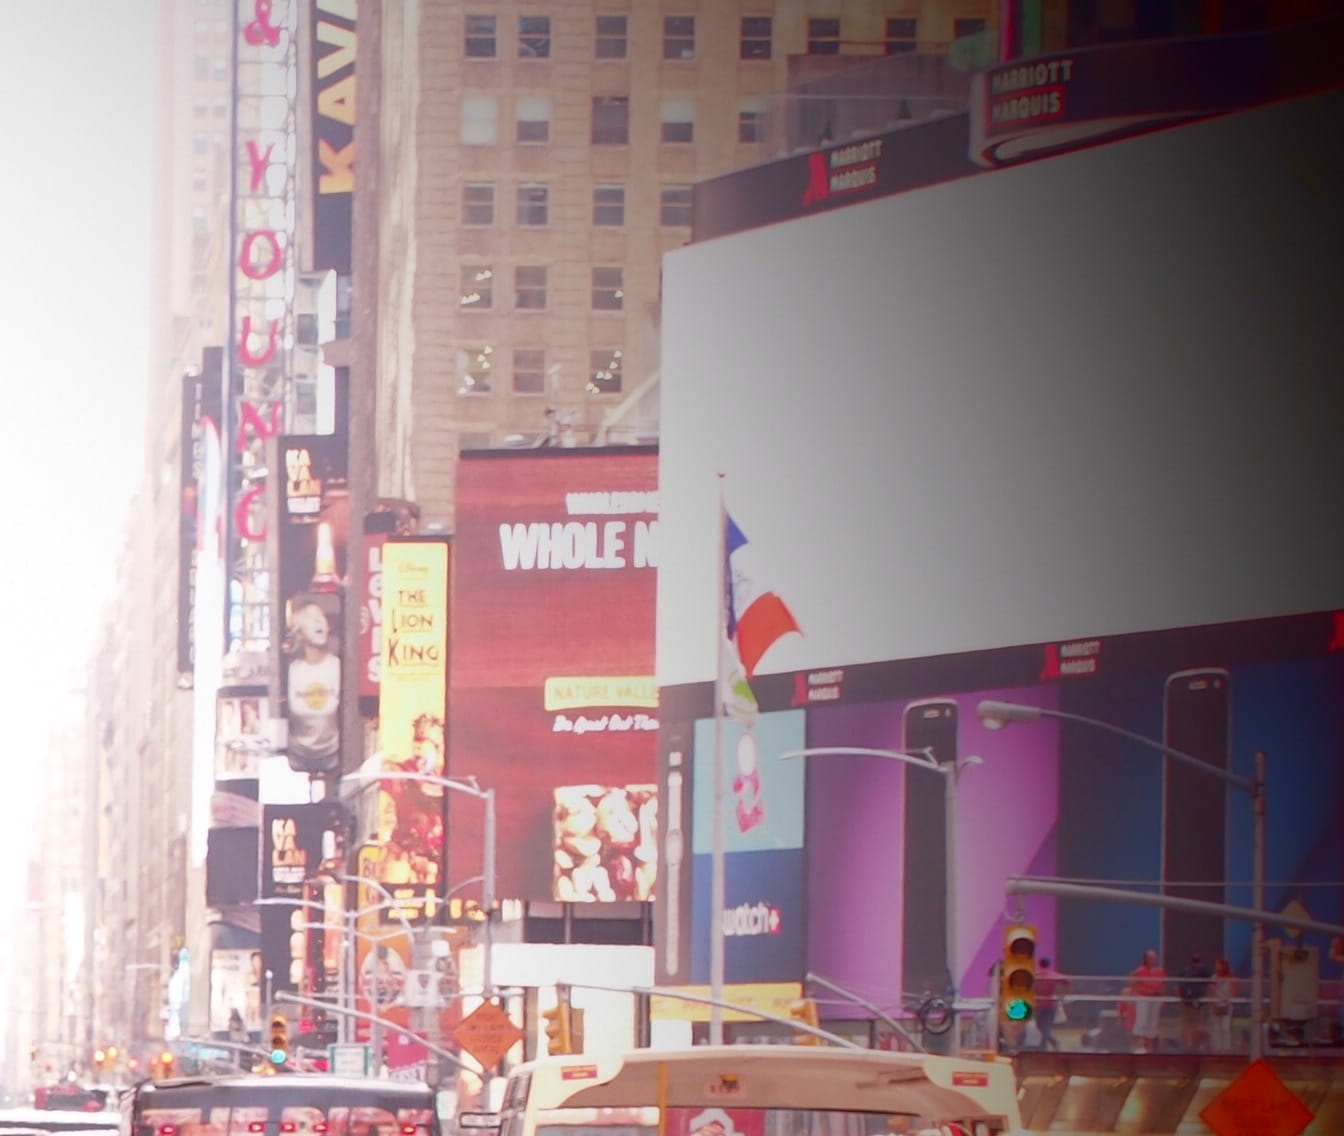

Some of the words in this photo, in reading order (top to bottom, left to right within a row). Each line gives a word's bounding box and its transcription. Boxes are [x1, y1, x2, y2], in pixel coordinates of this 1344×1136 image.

[992, 60, 1074, 93] MARRIOTT
[992, 92, 1060, 125] MARQUIS
[499, 520, 625, 572] WHOLE
[397, 588, 428, 607] THE
[390, 599, 434, 637] LION
[387, 637, 440, 669] KING
